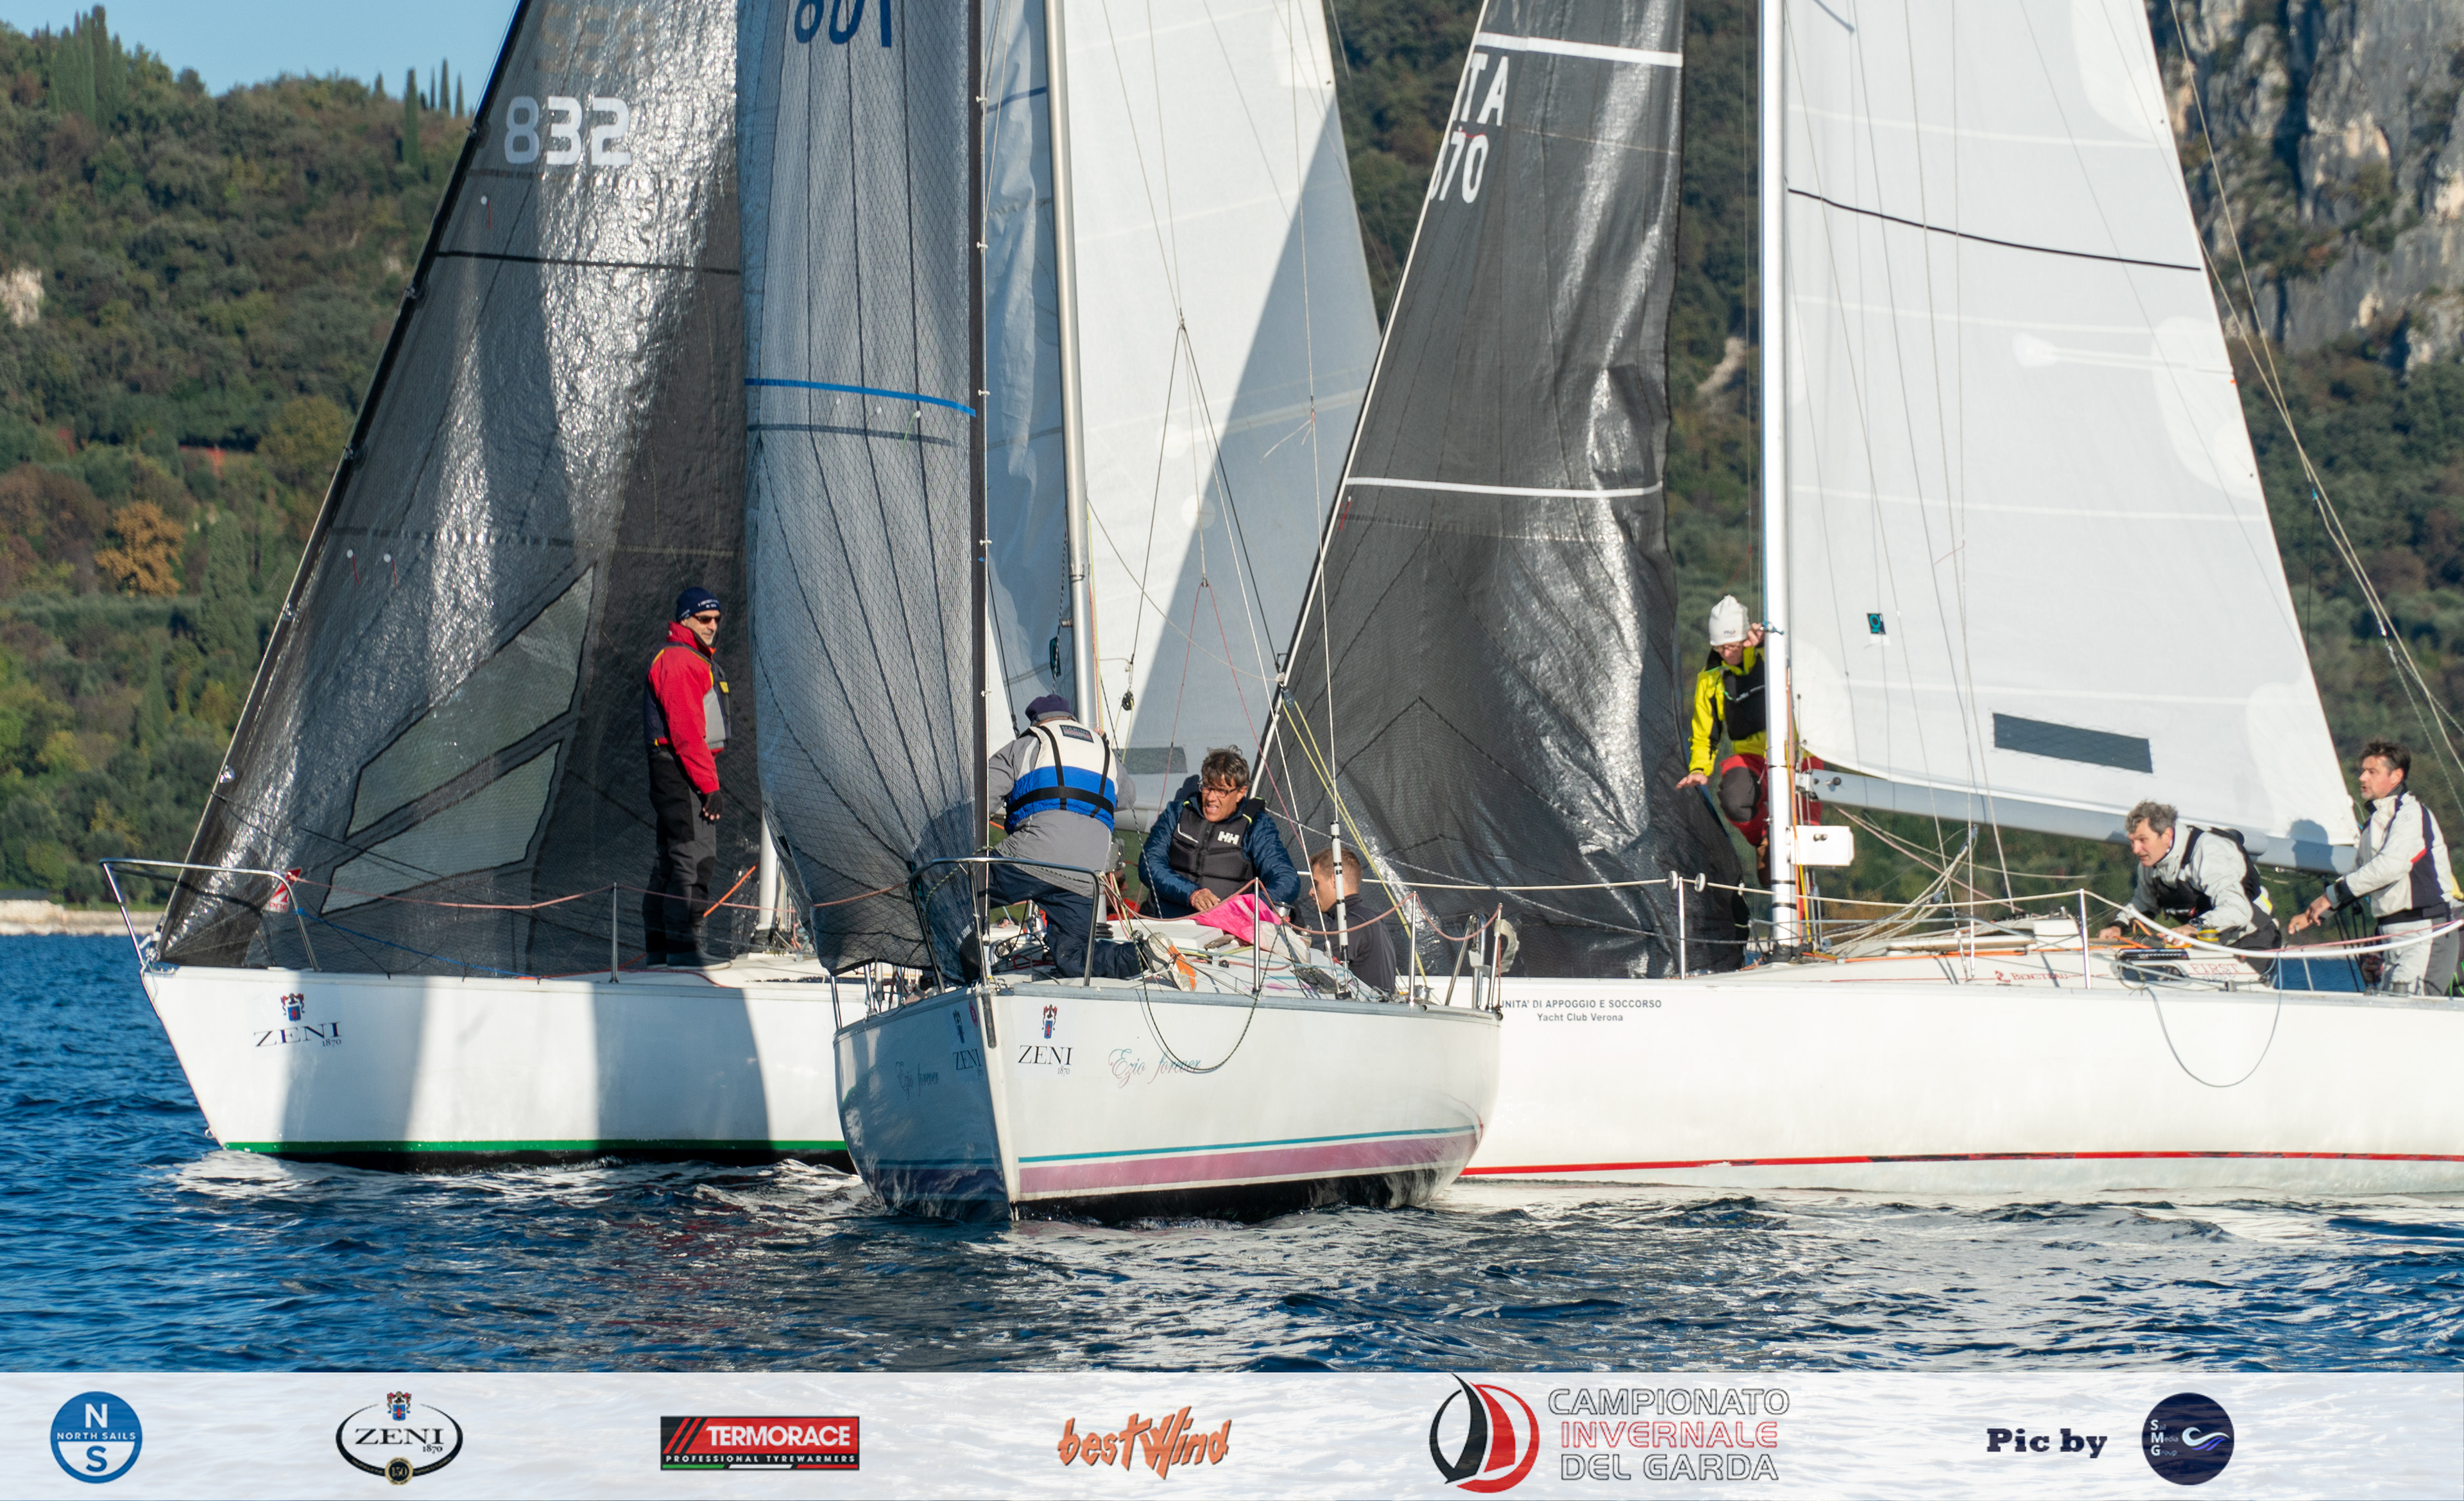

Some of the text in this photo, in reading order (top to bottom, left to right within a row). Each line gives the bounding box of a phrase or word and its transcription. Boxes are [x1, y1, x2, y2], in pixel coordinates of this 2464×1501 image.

[504, 96, 631, 166] 832
[1217, 830, 1240, 845] HH
[2188, 963, 2237, 973] FIRST
[1533, 1000, 1542, 1008] DI
[1546, 1000, 1596, 1008] APPOGGIO
[1600, 1000, 1605, 1008] E
[1609, 1000, 1662, 1008] SOCCORSO
[1537, 1013, 1564, 1022] Yacht
[253, 1022, 341, 1047] ZENI
[322, 1038, 342, 1047] 1870
[953, 1049, 982, 1070] ZENI
[1018, 1045, 1074, 1065] ZENI
[1057, 1066, 1070, 1077] 1870
[1108, 1049, 1202, 1088] Ezio forever
